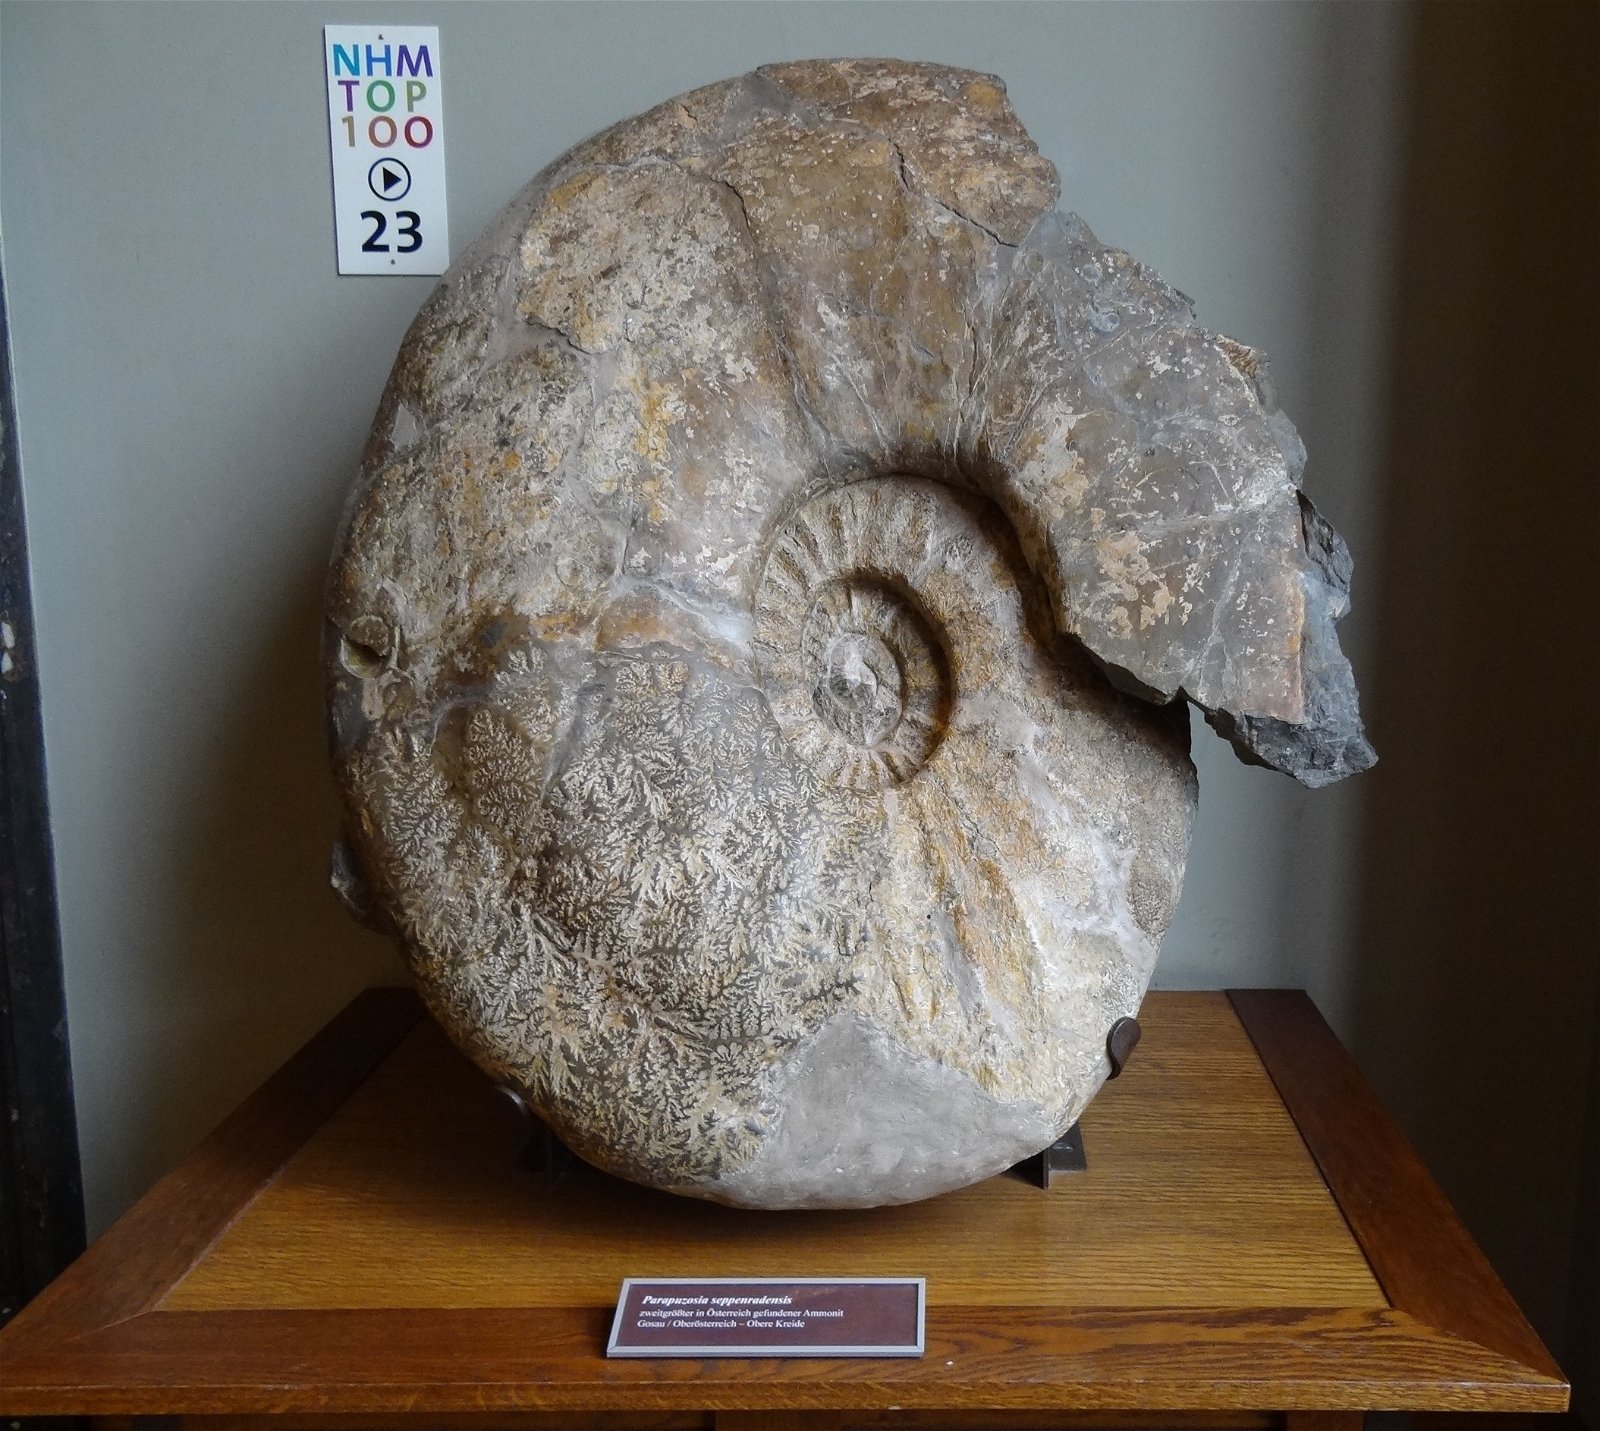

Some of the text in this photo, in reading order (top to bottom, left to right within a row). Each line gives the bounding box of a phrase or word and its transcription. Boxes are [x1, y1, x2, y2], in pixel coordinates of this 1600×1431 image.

[332, 44, 434, 77] NHM
[337, 80, 428, 113] TOP
[341, 115, 434, 149] 100
[360, 210, 424, 253] 23
[639, 1307, 845, 1318] zweitgrößter in Österreich gefundener Ammonit
[642, 1295, 793, 1306] Parapuzosia seppenradensis
[637, 1319, 666, 1328] Gosau
[672, 1319, 737, 1328] Oberösterreich
[746, 1319, 774, 1328] Obere
[775, 1319, 806, 1328] Kreide
